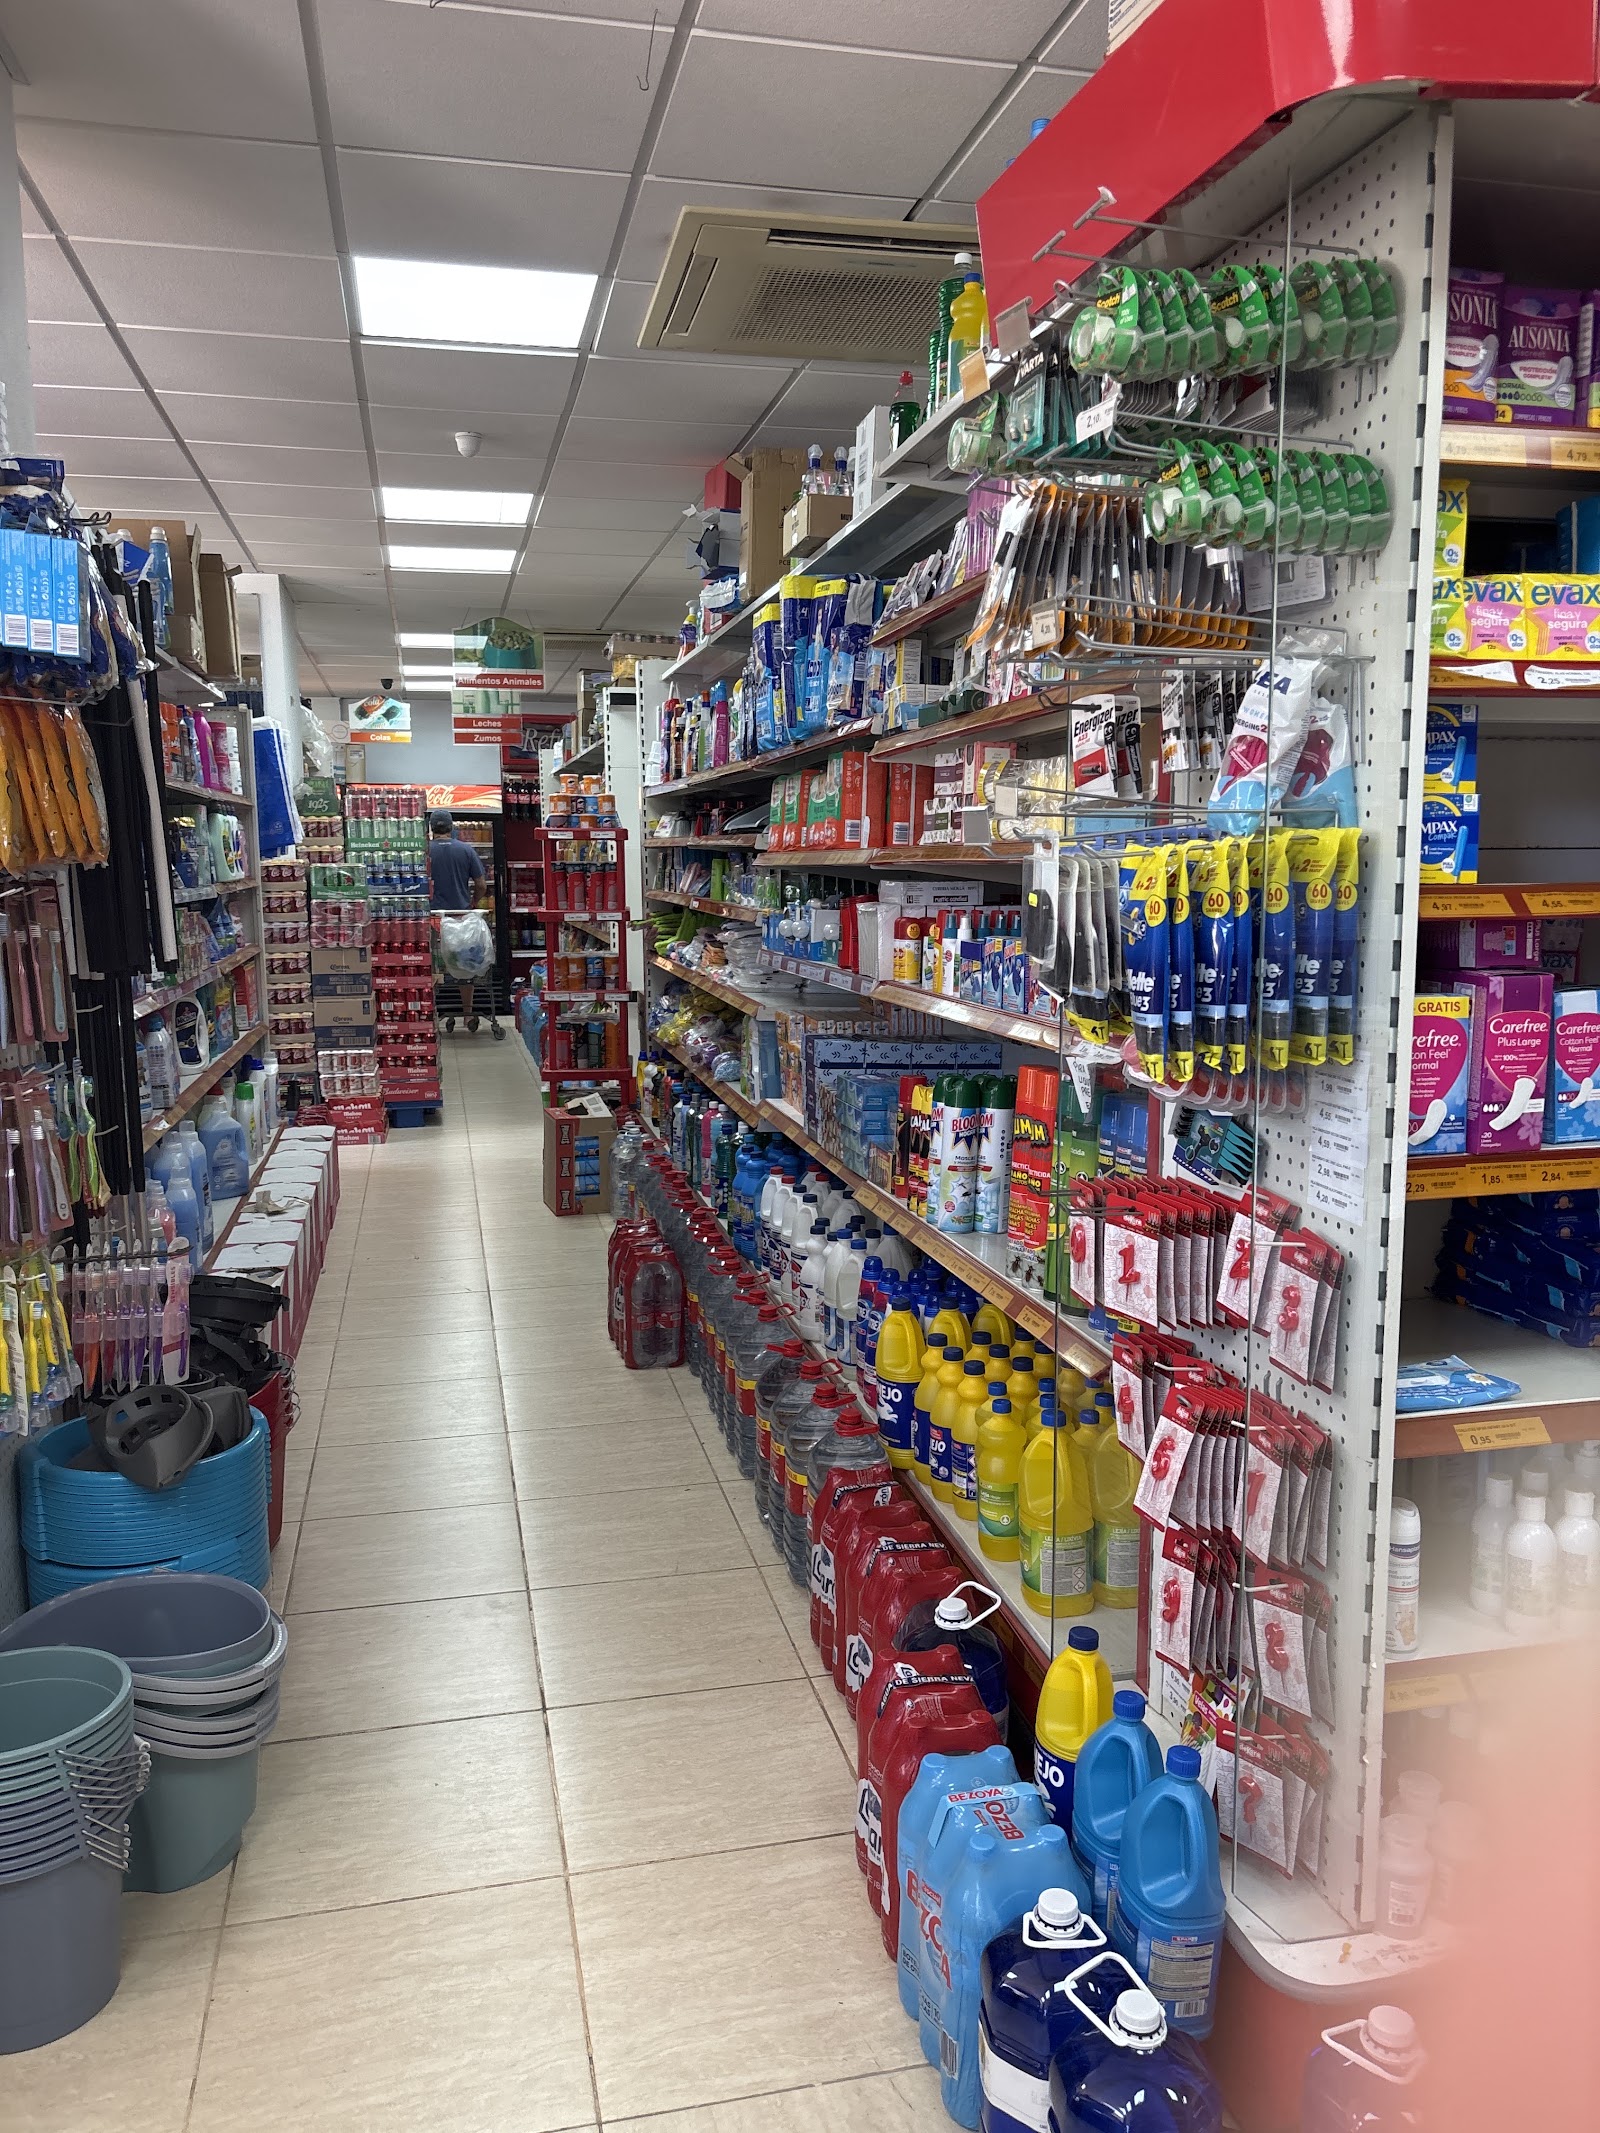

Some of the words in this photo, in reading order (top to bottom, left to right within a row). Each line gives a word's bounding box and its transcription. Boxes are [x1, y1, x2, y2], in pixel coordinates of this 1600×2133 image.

[1096, 292, 1120, 308] Scotch
[1211, 292, 1239, 313] Scotch
[1508, 325, 1571, 352] AUSONIA
[1020, 352, 1044, 378] VARTA
[1566, 449, 1588, 462] 4,79
[1161, 463, 1181, 481] Scotch
[1462, 580, 1522, 603] evax
[1531, 583, 1600, 606] evax
[1554, 609, 1572, 619] fina
[1470, 616, 1510, 628] segura
[1548, 618, 1588, 630] segura
[457, 676, 500, 686] Alimentos
[502, 676, 542, 686] Animales
[1257, 671, 1292, 696] EA
[472, 719, 502, 728] Leches
[1074, 706, 1114, 738] Energizer
[370, 734, 391, 742] Colas
[474, 734, 502, 742] Zumos
[308, 799, 330, 812] 1925
[1267, 887, 1282, 902] 60
[1312, 884, 1328, 898] 60
[1337, 885, 1352, 900] 60
[1208, 893, 1224, 908] 60
[1418, 1001, 1461, 1013] GRATIS
[1490, 1018, 1548, 1034] Carefree
[1498, 1036, 1516, 1047] Plus
[1518, 1038, 1542, 1048] Large
[1428, 1048, 1449, 1059] Feel
[1482, 1174, 1500, 1186] 1,85
[1542, 1170, 1561, 1182] 2,84
[1406, 1182, 1425, 1194] 2,29
[1470, 1434, 1492, 1446] 0,95
[880, 1683, 893, 1710] AGUA
[895, 1678, 910, 1686] DE
[911, 1676, 948, 1685] SIERRA
[947, 1788, 1004, 1804] BEZOYA
[984, 1800, 1024, 1842] BEZO
